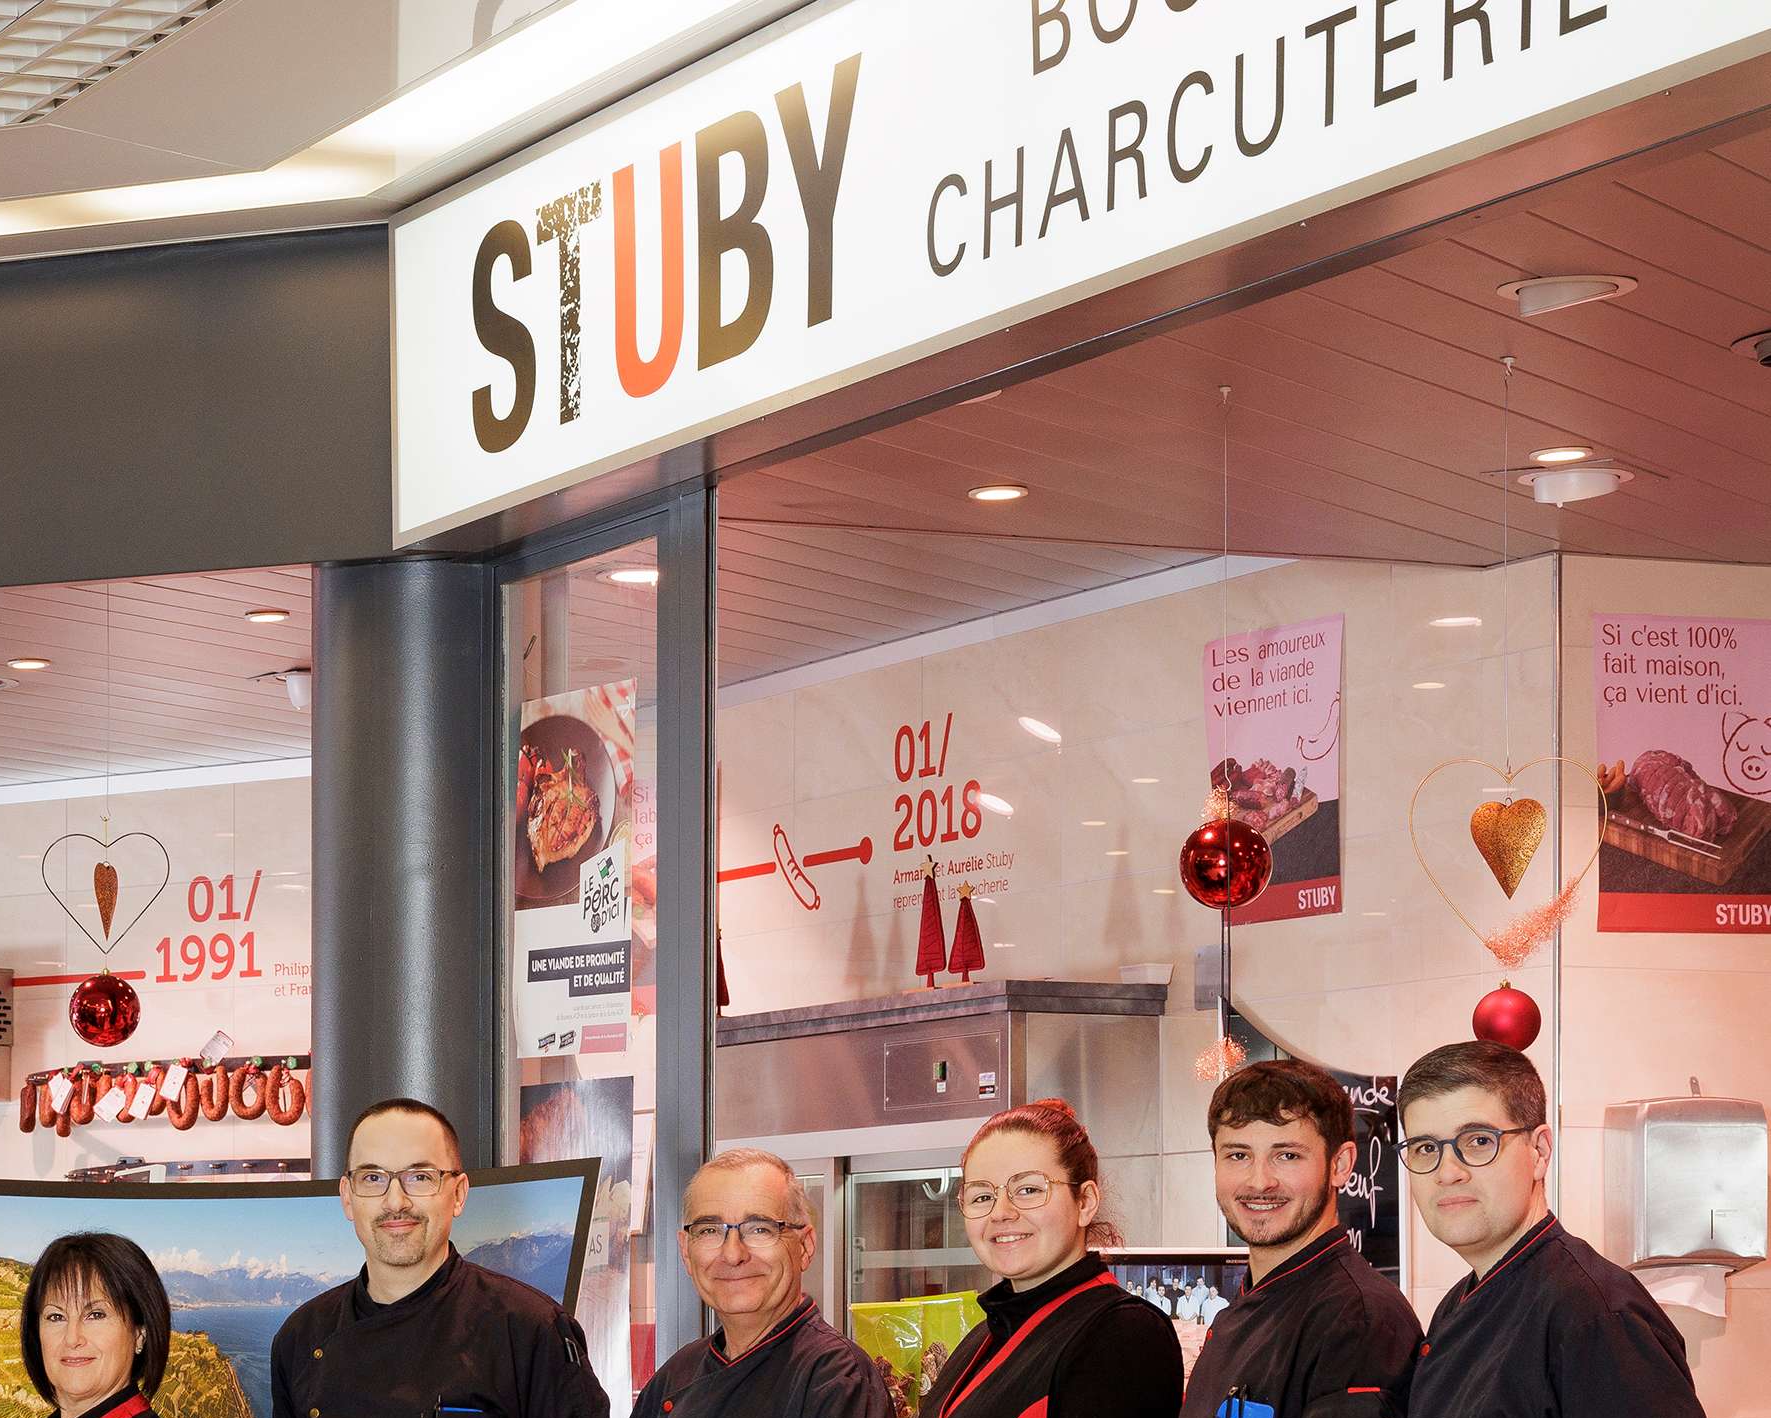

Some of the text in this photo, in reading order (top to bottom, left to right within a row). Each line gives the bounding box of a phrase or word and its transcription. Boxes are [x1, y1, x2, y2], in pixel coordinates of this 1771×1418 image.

[471, 52, 863, 455] STUBY
[1212, 632, 1326, 667] Les amoureux
[1602, 623, 1737, 650] Si c'est 100%
[1212, 658, 1315, 692] de la viande
[1603, 652, 1726, 680] fait maison,
[1214, 683, 1312, 717] viennent ici.
[1603, 682, 1743, 708] ça vient d'ici.
[894, 712, 954, 783] 01/
[632, 786, 649, 804] Si
[893, 779, 983, 852] 2018
[635, 833, 653, 850] ça
[947, 856, 984, 875] Aurélie
[986, 851, 1015, 870] Stuby
[188, 870, 263, 923] 01/
[583, 877, 620, 920] PORC
[584, 876, 594, 895] LE
[1298, 885, 1337, 910] STUBY
[601, 902, 620, 926] D'ICI
[1715, 903, 1771, 925] STUBY
[155, 931, 263, 984] 1991
[531, 948, 625, 973] UNE VIANDE DE PROXIMITÉ
[274, 984, 285, 997] et
[573, 968, 625, 988] ET DE QUALITÉ
